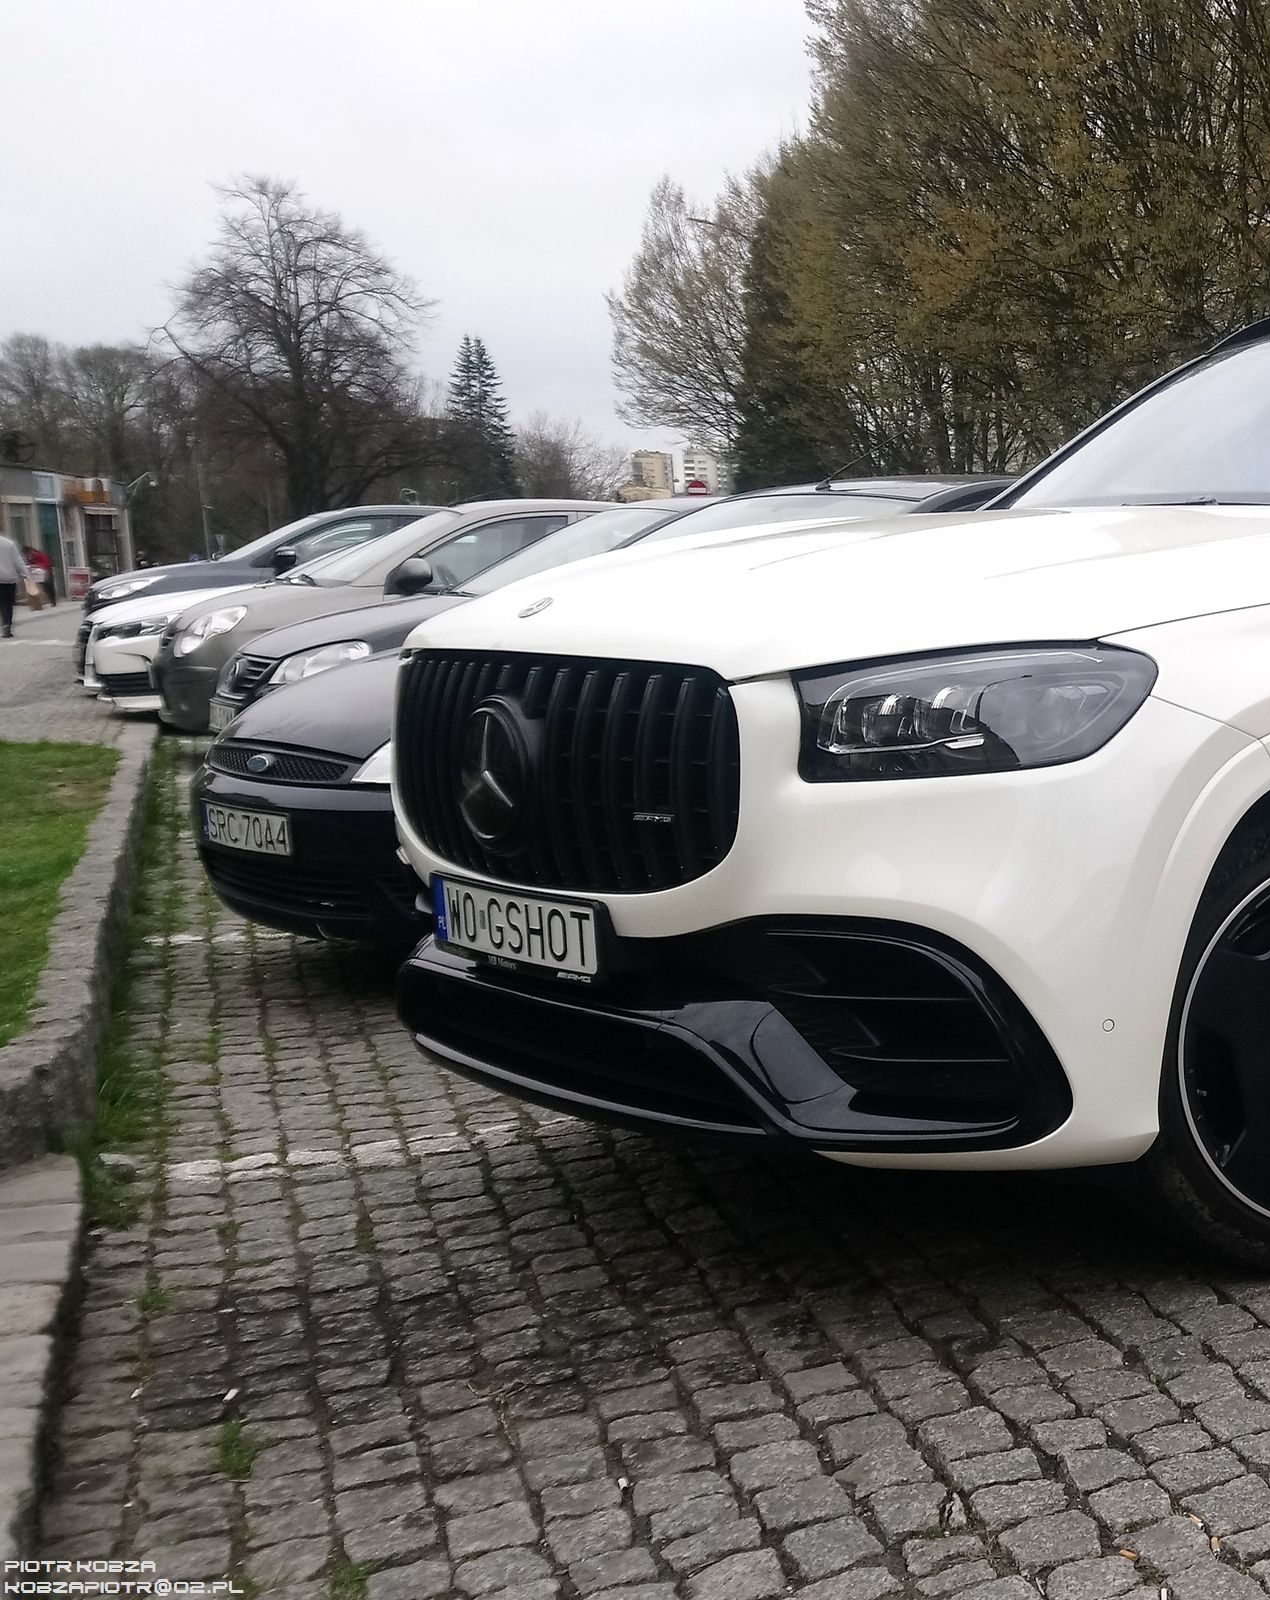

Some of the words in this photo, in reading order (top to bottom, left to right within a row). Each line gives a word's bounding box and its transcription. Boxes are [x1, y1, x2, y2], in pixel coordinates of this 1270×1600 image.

[208, 808, 239, 844] SRC
[241, 814, 287, 853] 70A4
[446, 887, 476, 942] WO
[487, 897, 590, 967] GSHOT
